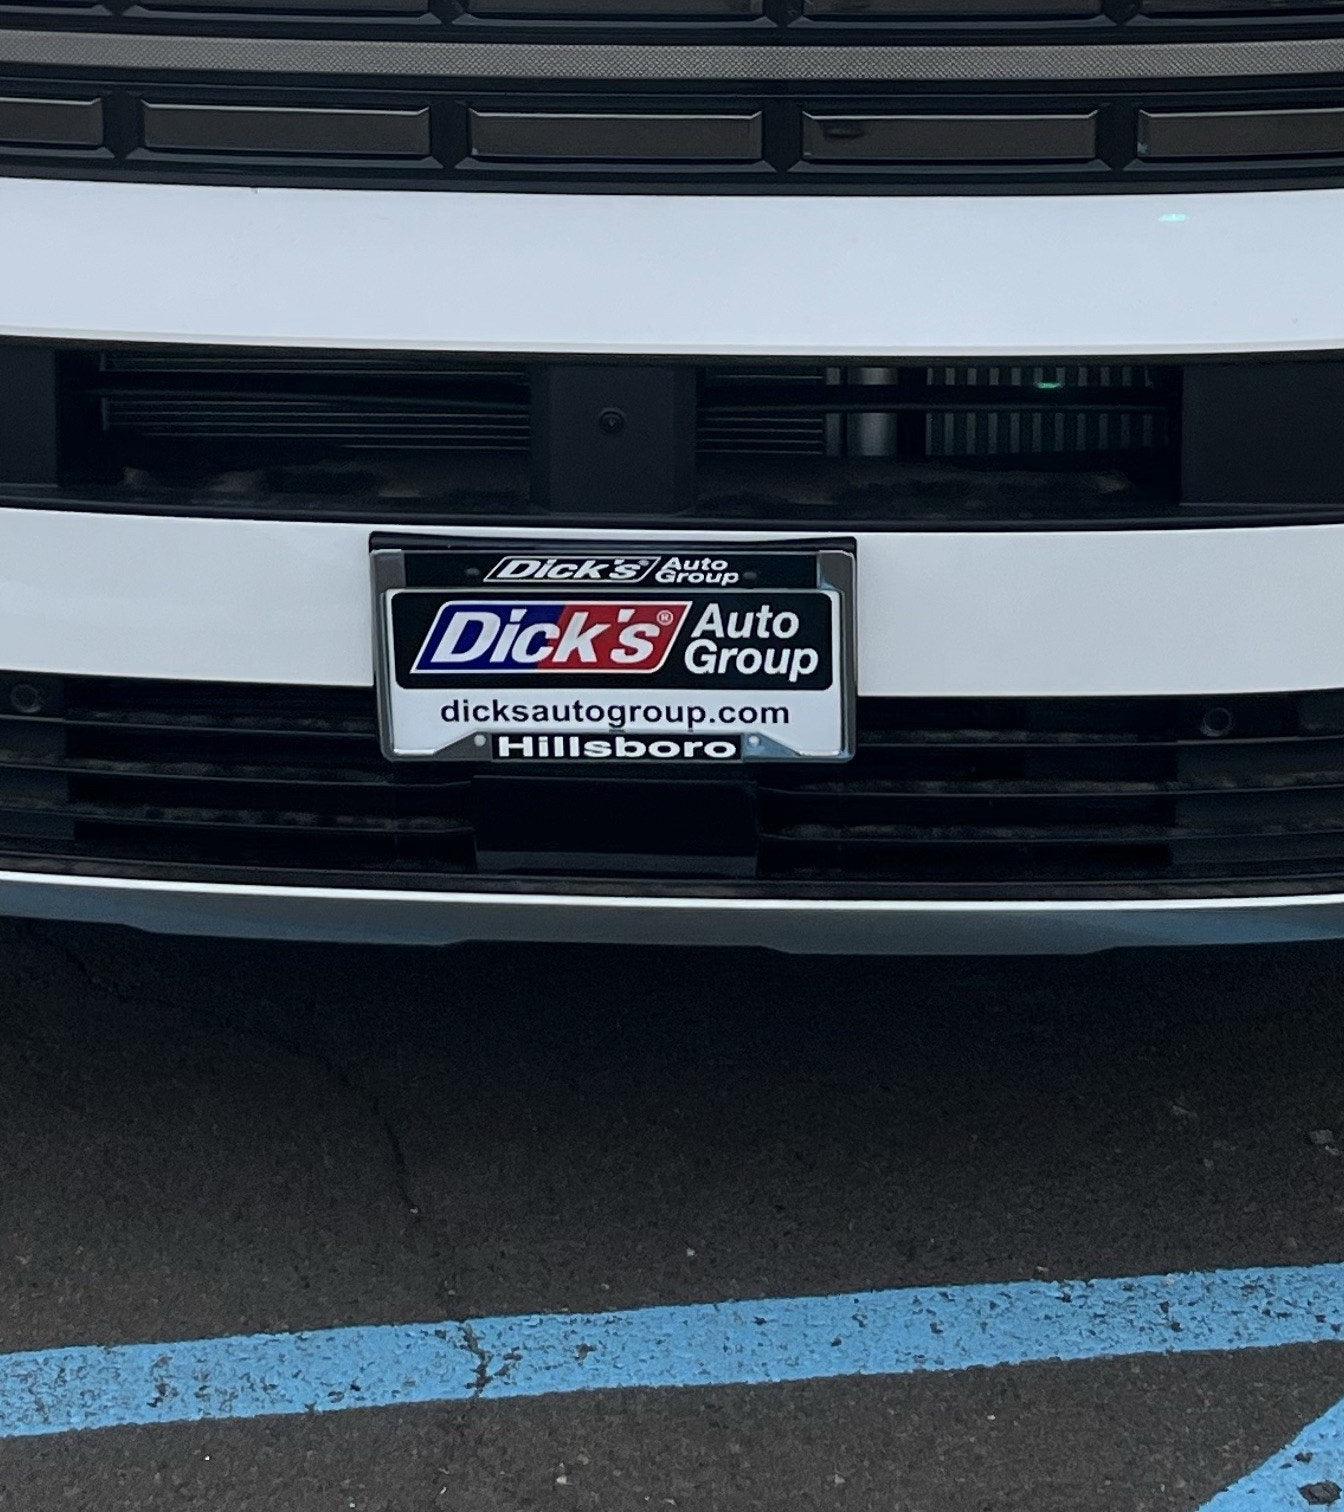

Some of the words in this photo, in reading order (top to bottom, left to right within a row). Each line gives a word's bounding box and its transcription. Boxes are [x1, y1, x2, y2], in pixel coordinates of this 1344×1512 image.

[496, 558, 641, 579] Dick's
[660, 557, 729, 571] Auto
[655, 569, 739, 586] Group
[691, 602, 800, 639] Auto
[684, 639, 820, 683] Group
[440, 699, 790, 729] dicksautogroup.com
[497, 735, 737, 758] Hillsboro
